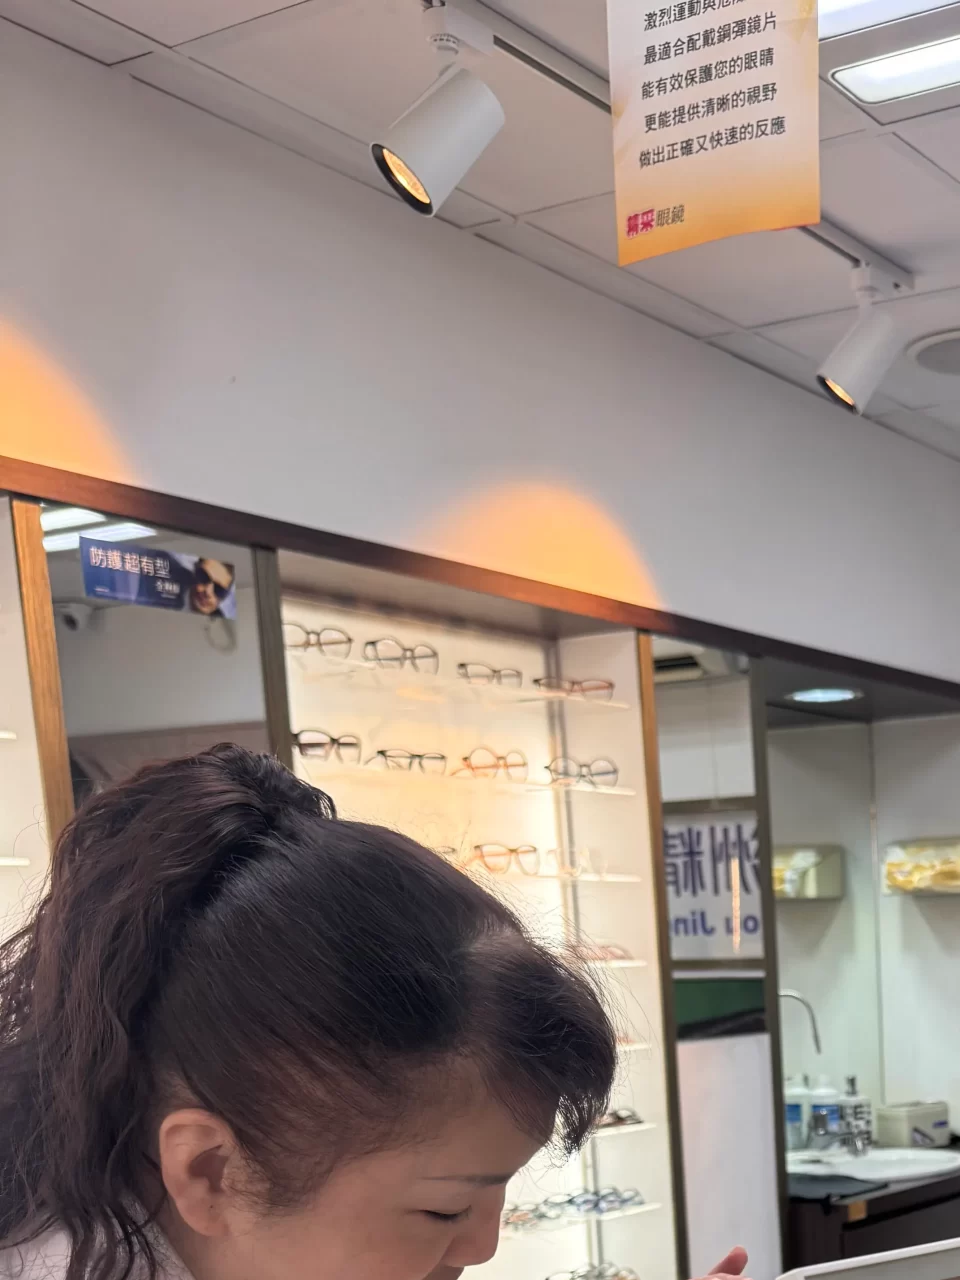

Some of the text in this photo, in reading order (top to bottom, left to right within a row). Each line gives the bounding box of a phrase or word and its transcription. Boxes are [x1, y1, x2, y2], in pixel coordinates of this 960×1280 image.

[643, 12, 777, 66] 最適合配戴鋼彈鏡片
[641, 47, 775, 100] 能有效保護您的眼睛
[644, 83, 778, 133] 更能提供清晰的視野
[638, 117, 787, 168] 做出正確又快速的反應
[89, 545, 171, 579] 防護超有型
